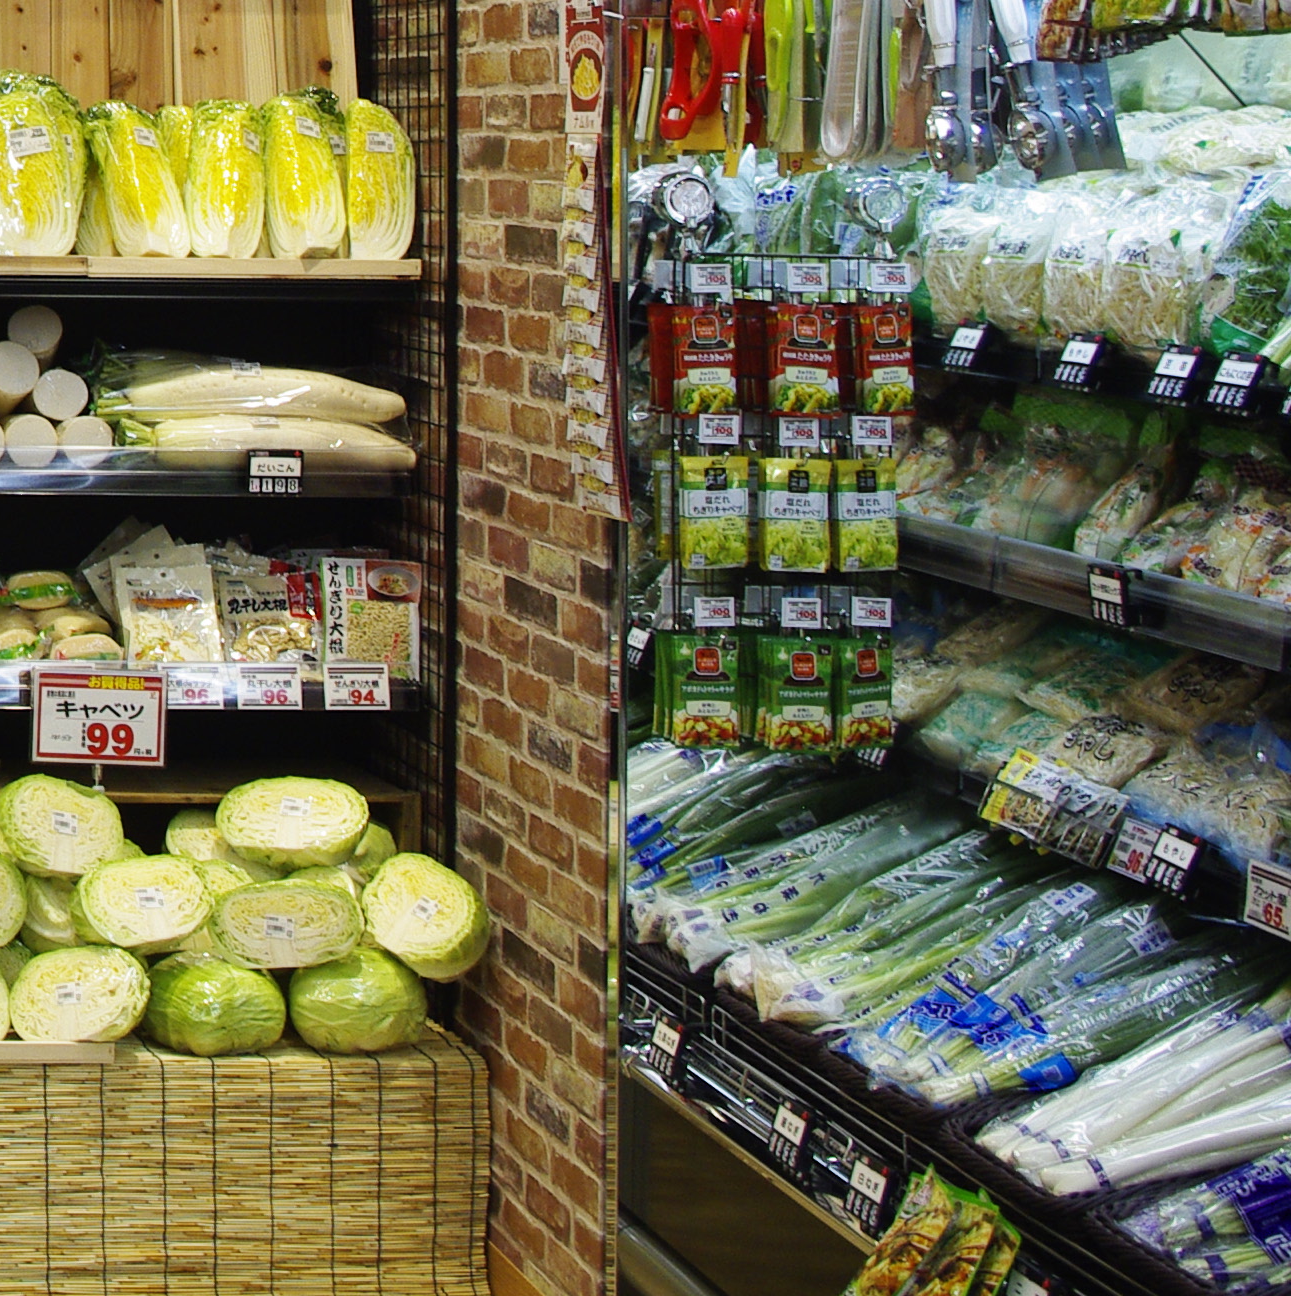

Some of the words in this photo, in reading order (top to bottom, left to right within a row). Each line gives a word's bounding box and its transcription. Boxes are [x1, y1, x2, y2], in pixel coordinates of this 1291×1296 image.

[257, 462, 295, 472] だいこん
[227, 598, 288, 615] 丸干し大根
[327, 561, 344, 655] せんぎり大根
[88, 676, 145, 690] お買得品!
[263, 689, 288, 704] 96
[350, 689, 375, 704] 94
[56, 700, 145, 720] キャベツ
[86, 723, 134, 755] 99
[1262, 903, 1283, 927] 65
